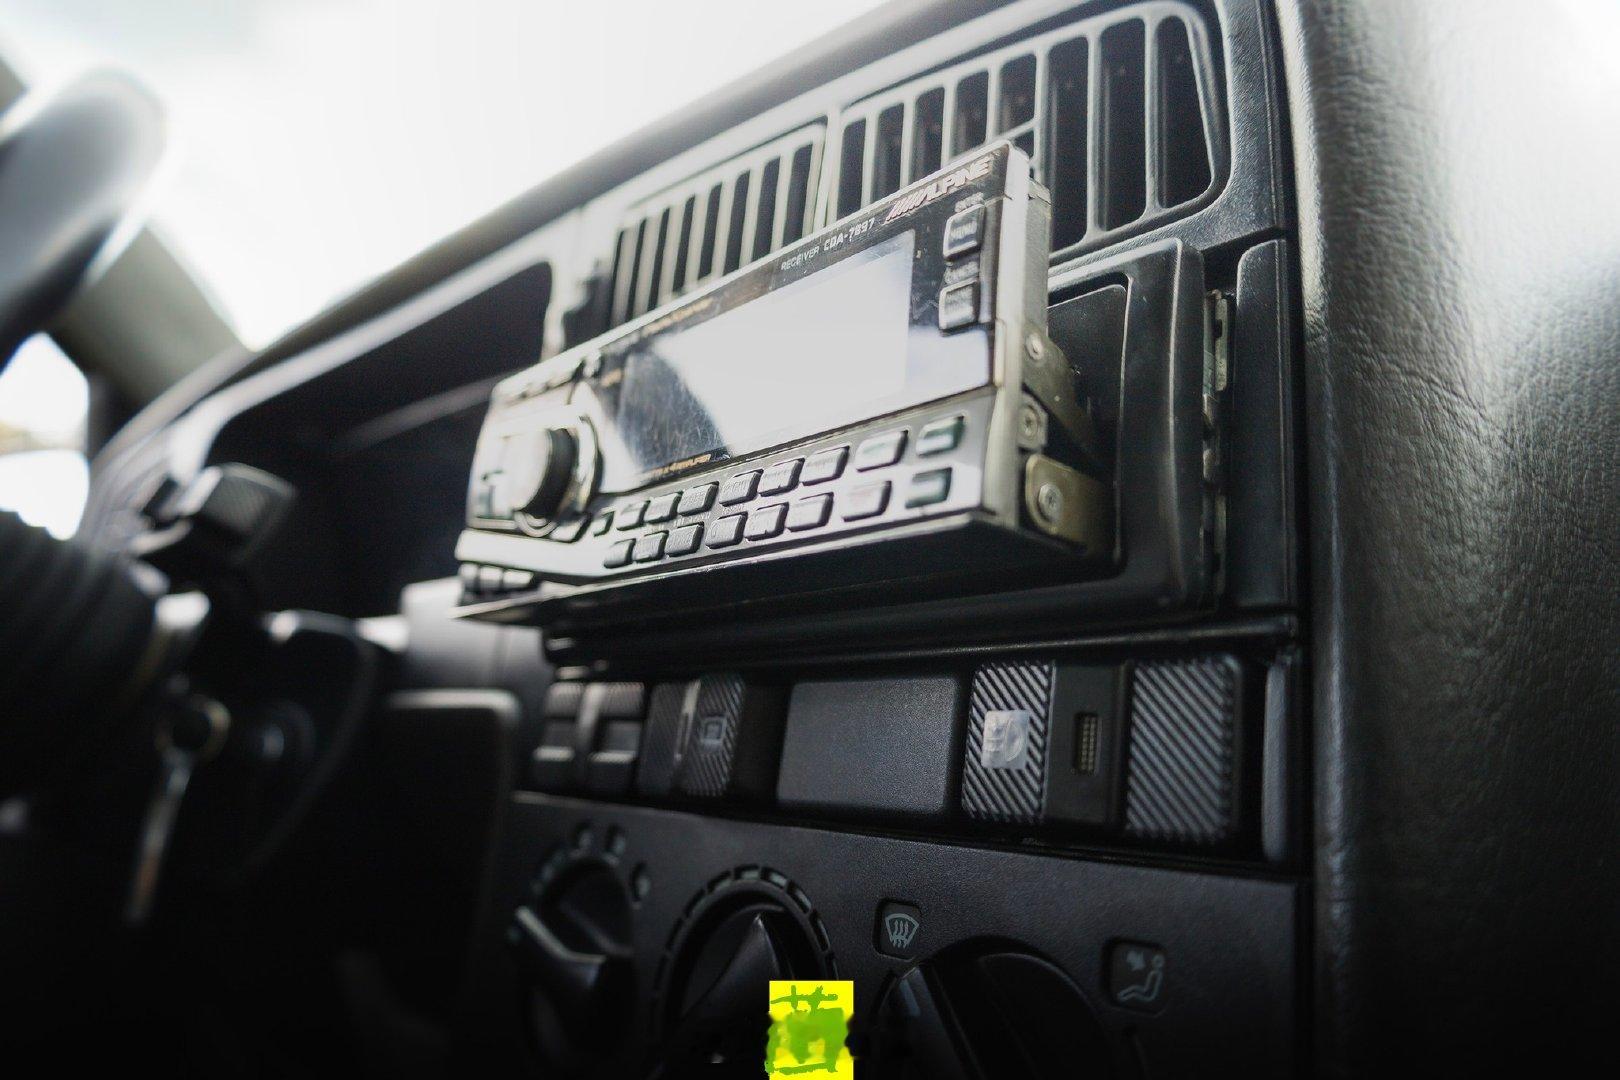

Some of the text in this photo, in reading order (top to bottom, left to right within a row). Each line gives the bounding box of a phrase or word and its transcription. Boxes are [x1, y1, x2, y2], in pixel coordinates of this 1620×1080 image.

[885, 155, 991, 222] ALPINE
[781, 218, 875, 270] RECEIVER CDA-7897
